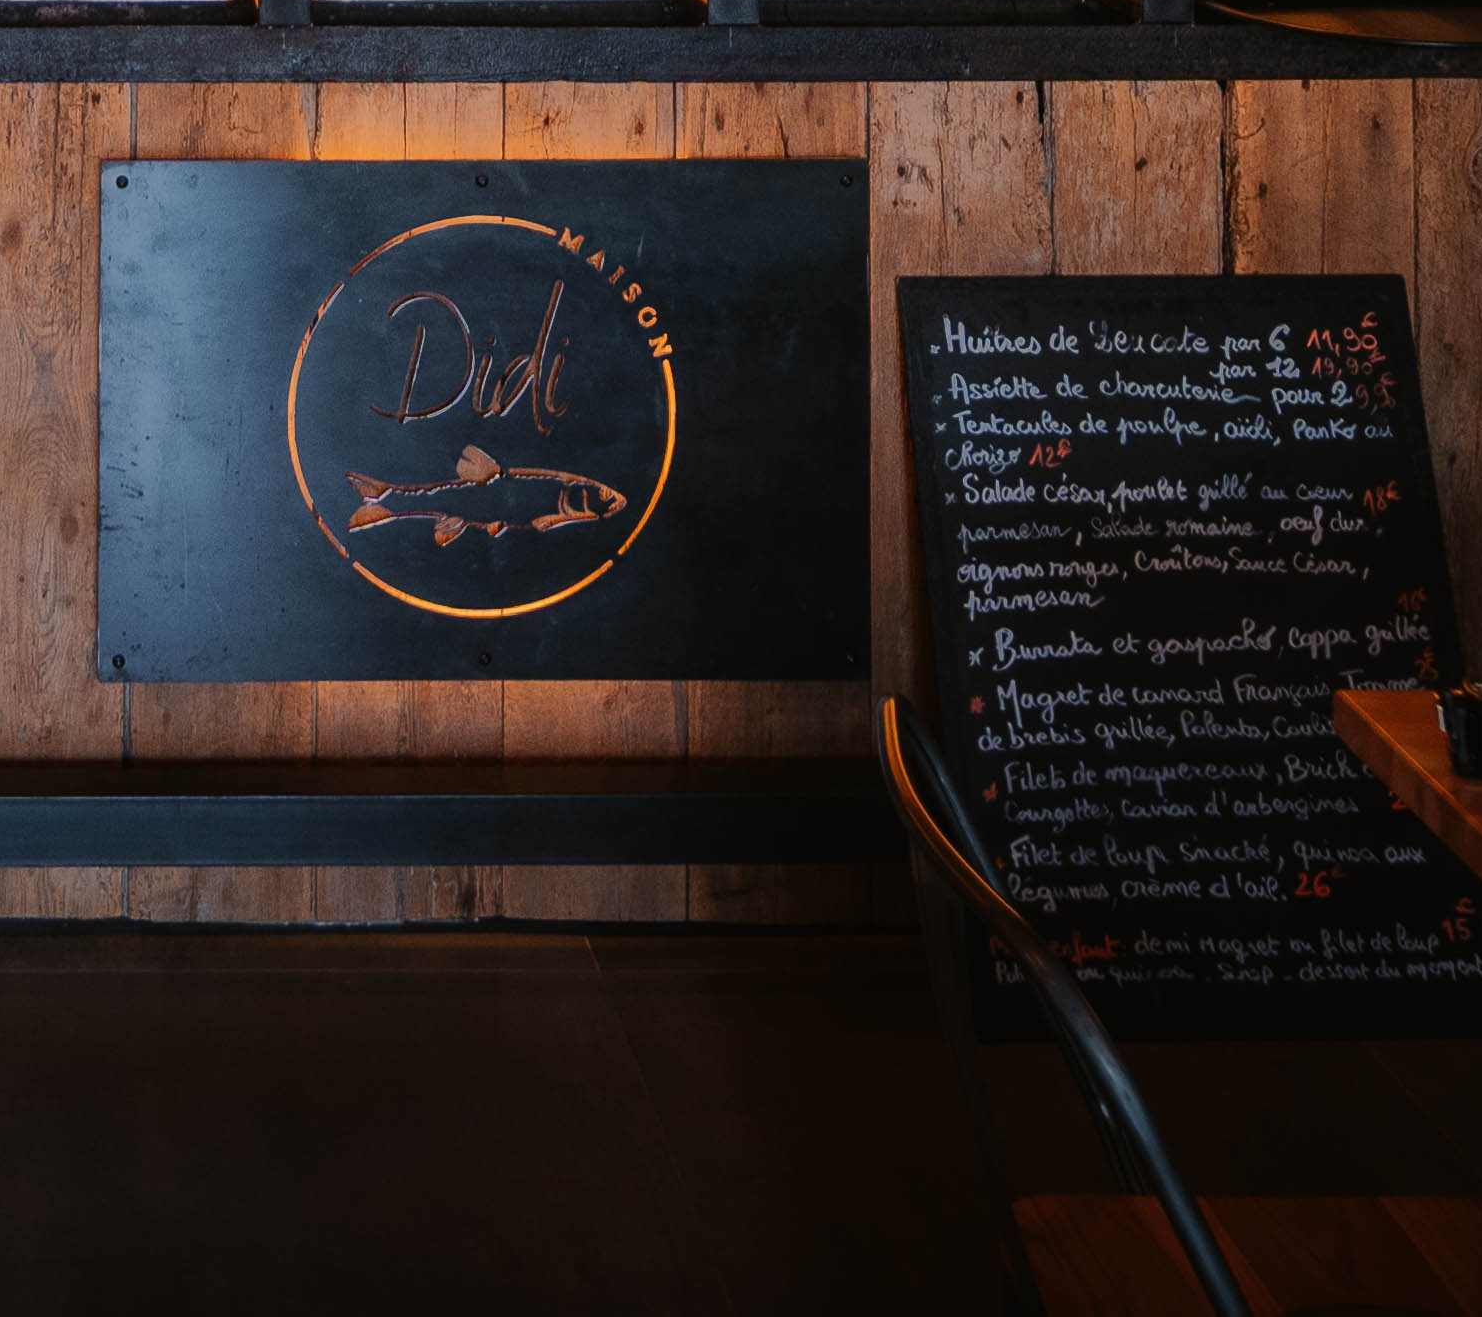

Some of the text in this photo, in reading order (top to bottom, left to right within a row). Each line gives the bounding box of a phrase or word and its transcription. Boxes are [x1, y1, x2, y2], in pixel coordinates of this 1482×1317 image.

[554, 225, 673, 359] MAISON
[369, 278, 571, 437] Didi
[1049, 326, 1078, 354] de
[1221, 334, 1262, 366] par
[1268, 325, 1290, 353] 6
[950, 372, 1048, 401] Assiette
[1056, 368, 1084, 396] de
[1271, 389, 1325, 416] pour
[1328, 380, 1352, 406] 2
[1210, 360, 1258, 384] par
[1265, 360, 1300, 379] 12
[954, 410, 1072, 438] Tentacules
[1080, 411, 1108, 437] de
[1364, 422, 1394, 439] au
[963, 474, 1036, 505] Salade
[1114, 482, 1189, 515] poulet
[1197, 472, 1254, 515] grillé
[1261, 485, 1288, 502] au
[957, 561, 1046, 595] oignons
[964, 591, 1105, 622] parmesan
[992, 627, 1103, 670] Burrata
[1113, 626, 1140, 654] et
[996, 678, 1095, 727] Magret
[1098, 684, 1127, 706] de
[1132, 678, 1225, 706] canard
[977, 729, 1003, 752] de
[1006, 721, 1087, 750] brebis
[1072, 759, 1097, 785] de
[1010, 835, 1063, 868] Filet
[1070, 842, 1098, 866] de
[1103, 837, 1171, 876] loup
[1293, 838, 1381, 867] quinoa
[1386, 842, 1428, 864] aux
[1121, 877, 1202, 900] crème
[1134, 929, 1191, 956] demi
[1319, 926, 1366, 960] filet
[1369, 931, 1392, 953] de
[1395, 919, 1439, 955] loup
